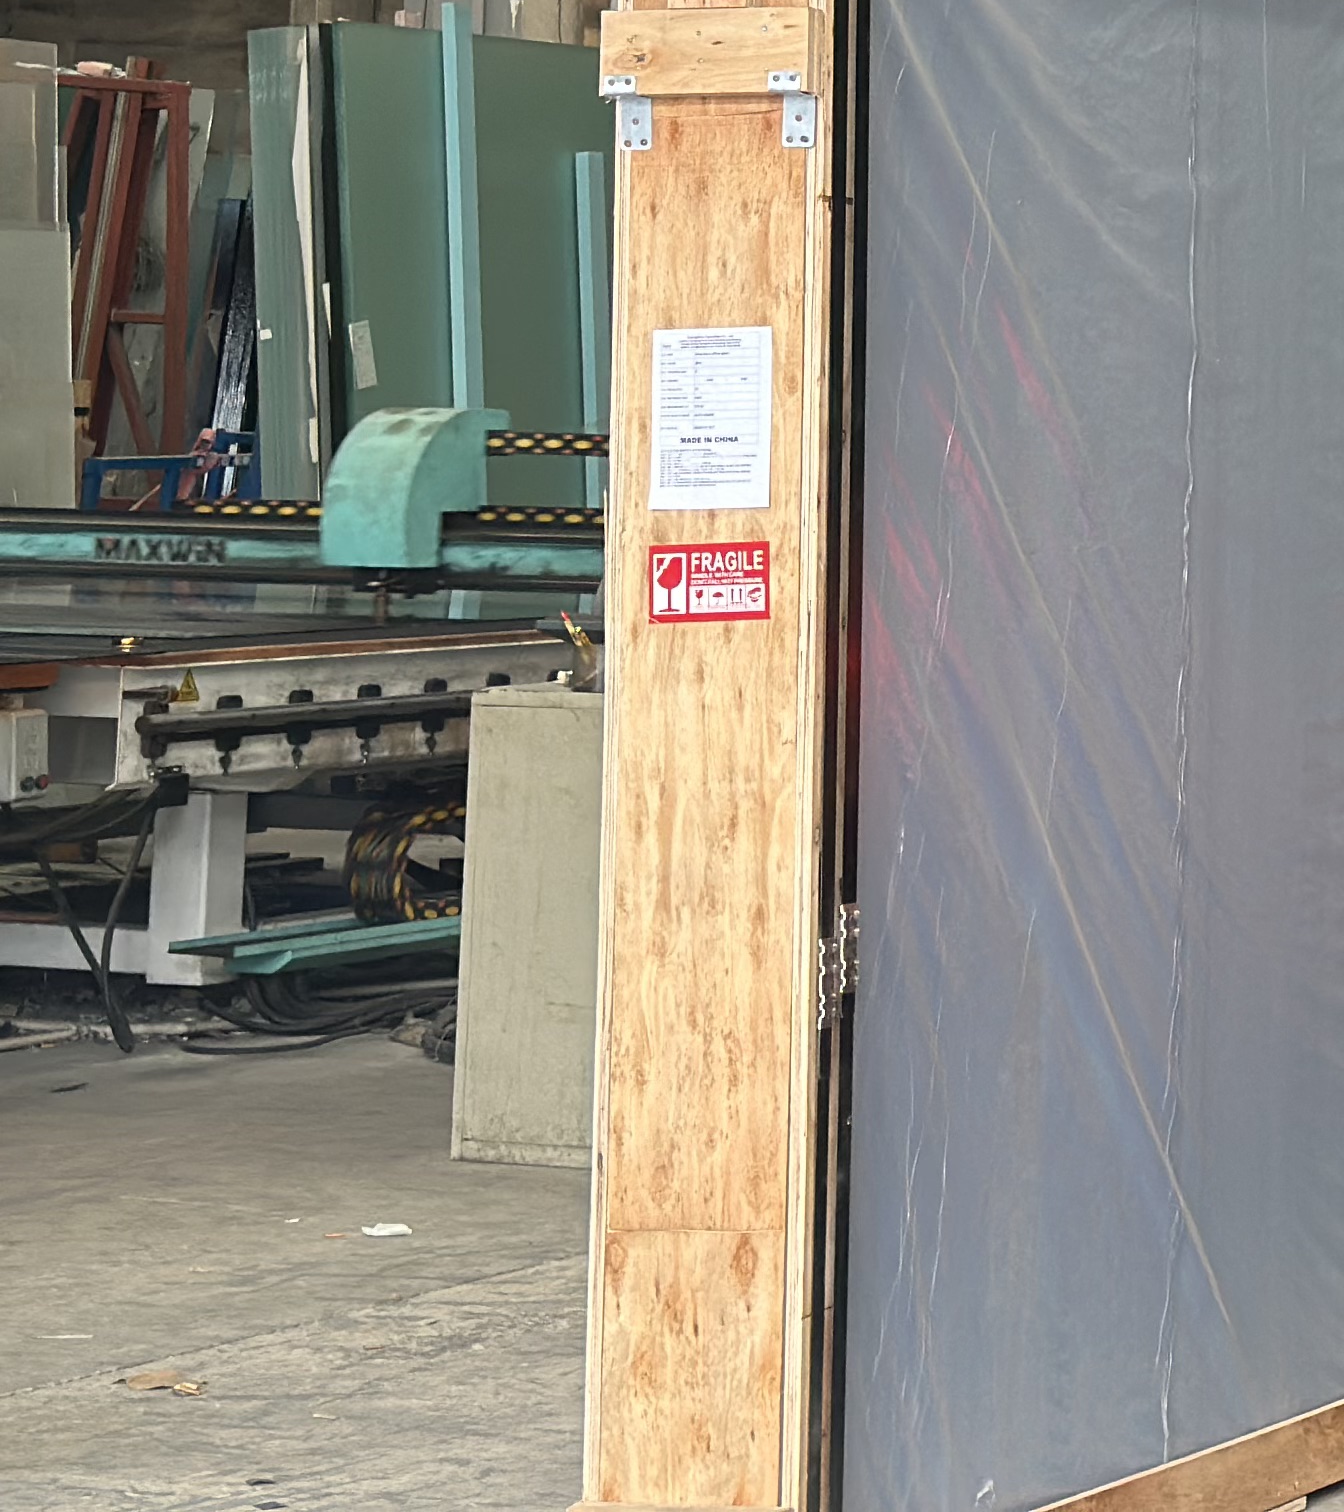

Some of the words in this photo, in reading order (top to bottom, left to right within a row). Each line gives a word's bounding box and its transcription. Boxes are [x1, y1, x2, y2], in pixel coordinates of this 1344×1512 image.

[680, 436, 702, 444] MADE
[714, 435, 739, 443] CHINA
[690, 550, 764, 572] FRAGILE
